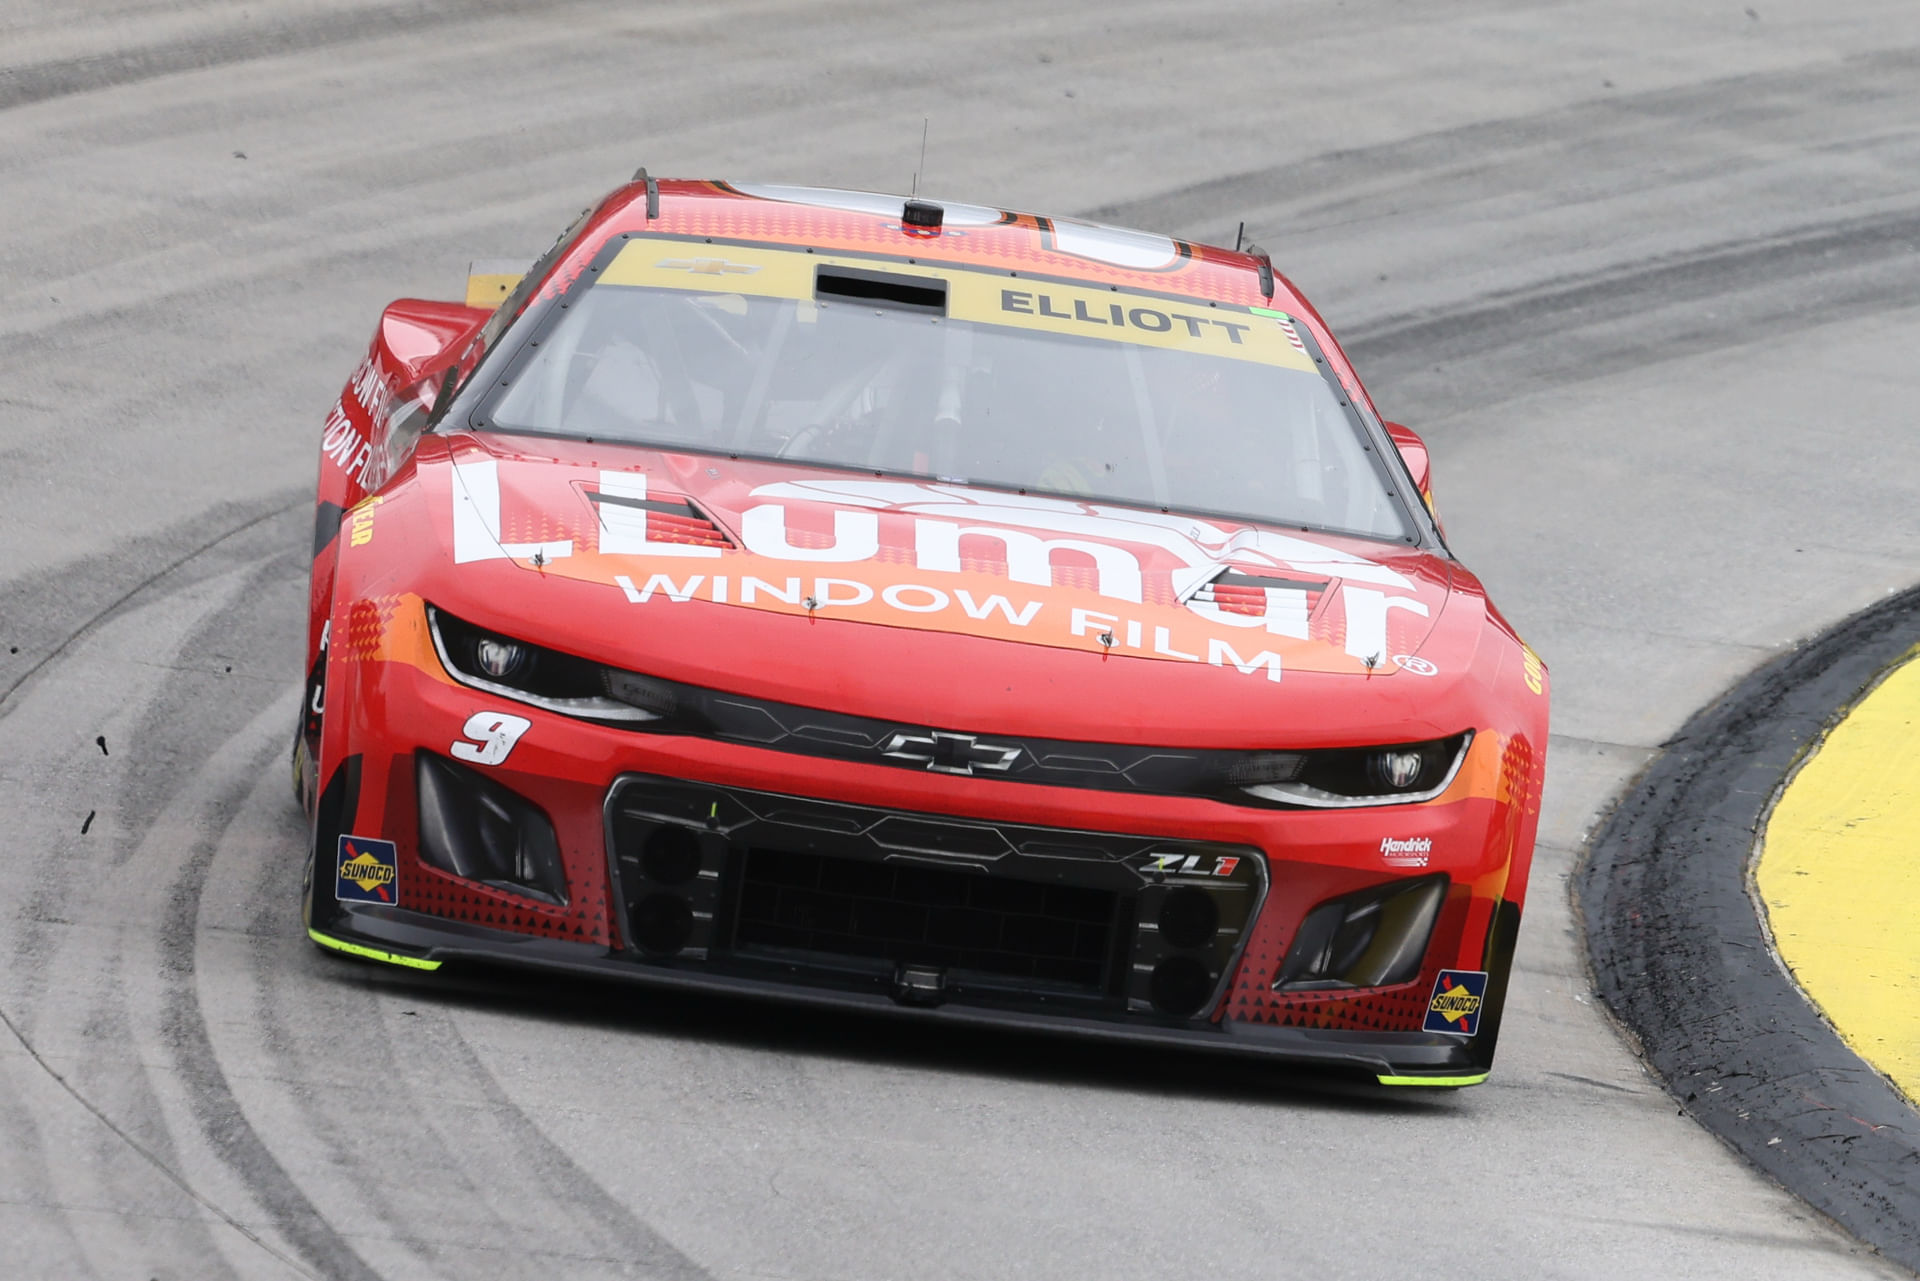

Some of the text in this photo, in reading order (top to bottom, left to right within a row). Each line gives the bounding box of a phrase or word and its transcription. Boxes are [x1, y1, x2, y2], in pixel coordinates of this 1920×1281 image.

[1001, 289, 1251, 344] ELLIOTT
[451, 461, 1430, 667] LLumar
[614, 573, 1282, 683] WINDOW FILM
[450, 711, 533, 767] 9
[1139, 853, 1240, 876] ZL1
[1380, 837, 1432, 856] Hendrick
[343, 862, 393, 882] SUNOCO
[1434, 995, 1479, 1013] SUNOCO
